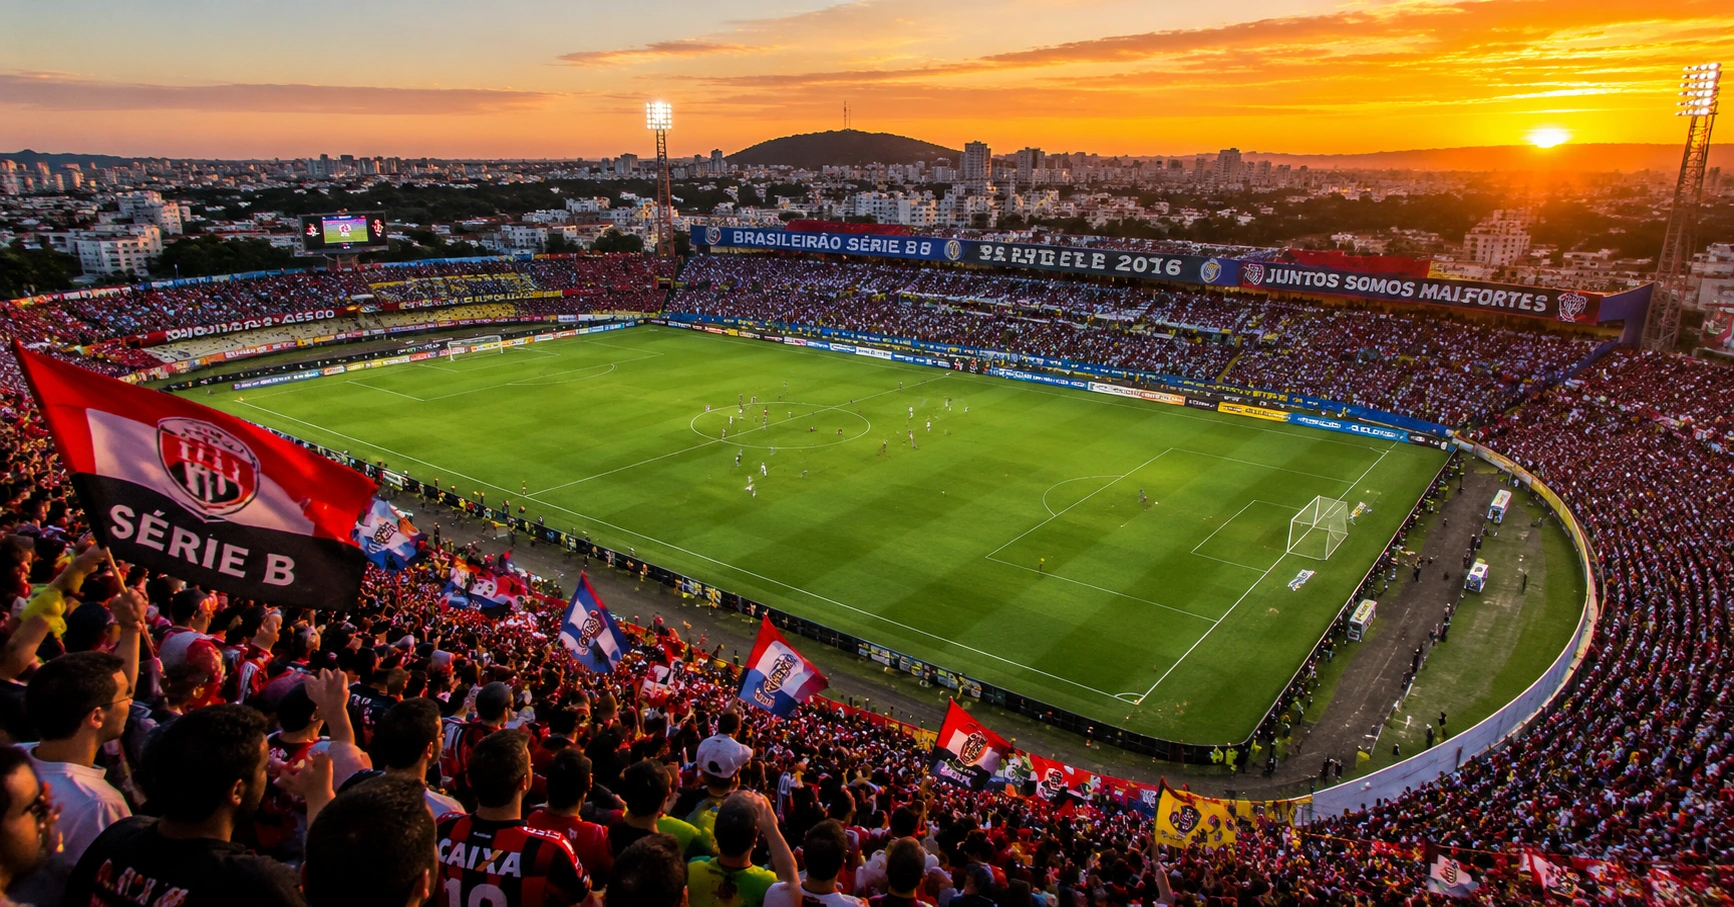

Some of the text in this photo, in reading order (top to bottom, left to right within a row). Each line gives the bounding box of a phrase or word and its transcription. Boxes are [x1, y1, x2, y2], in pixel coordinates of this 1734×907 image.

[846, 235, 900, 254] SÉRIE
[1115, 254, 1182, 276] 2016
[1265, 268, 1340, 288] JUNTOS
[1344, 275, 1416, 298] SOMOS
[109, 504, 295, 586] SÉRIE B
[438, 837, 522, 878] CAIXA
